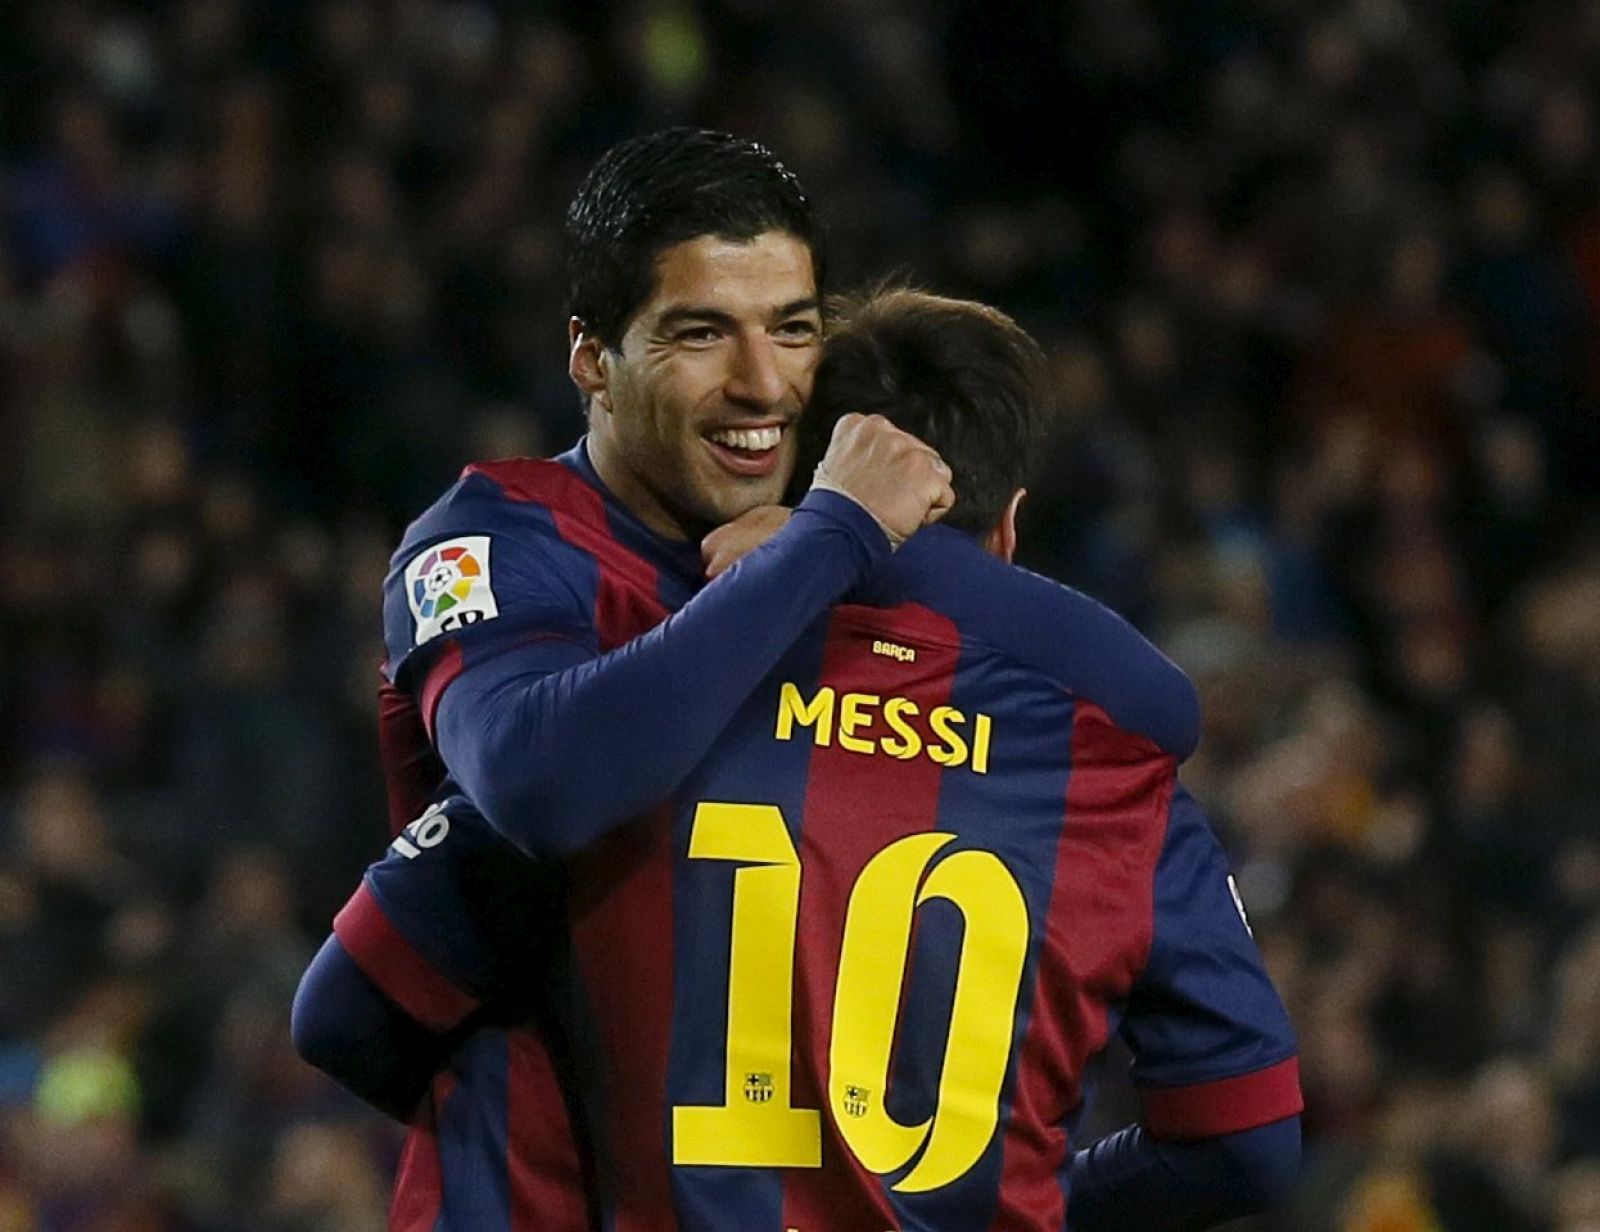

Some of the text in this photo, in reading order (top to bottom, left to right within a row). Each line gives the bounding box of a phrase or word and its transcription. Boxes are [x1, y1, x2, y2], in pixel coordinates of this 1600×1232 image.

[872, 641, 915, 662] BARÇA
[776, 682, 991, 774] MESSI
[672, 802, 1030, 1193] 10
